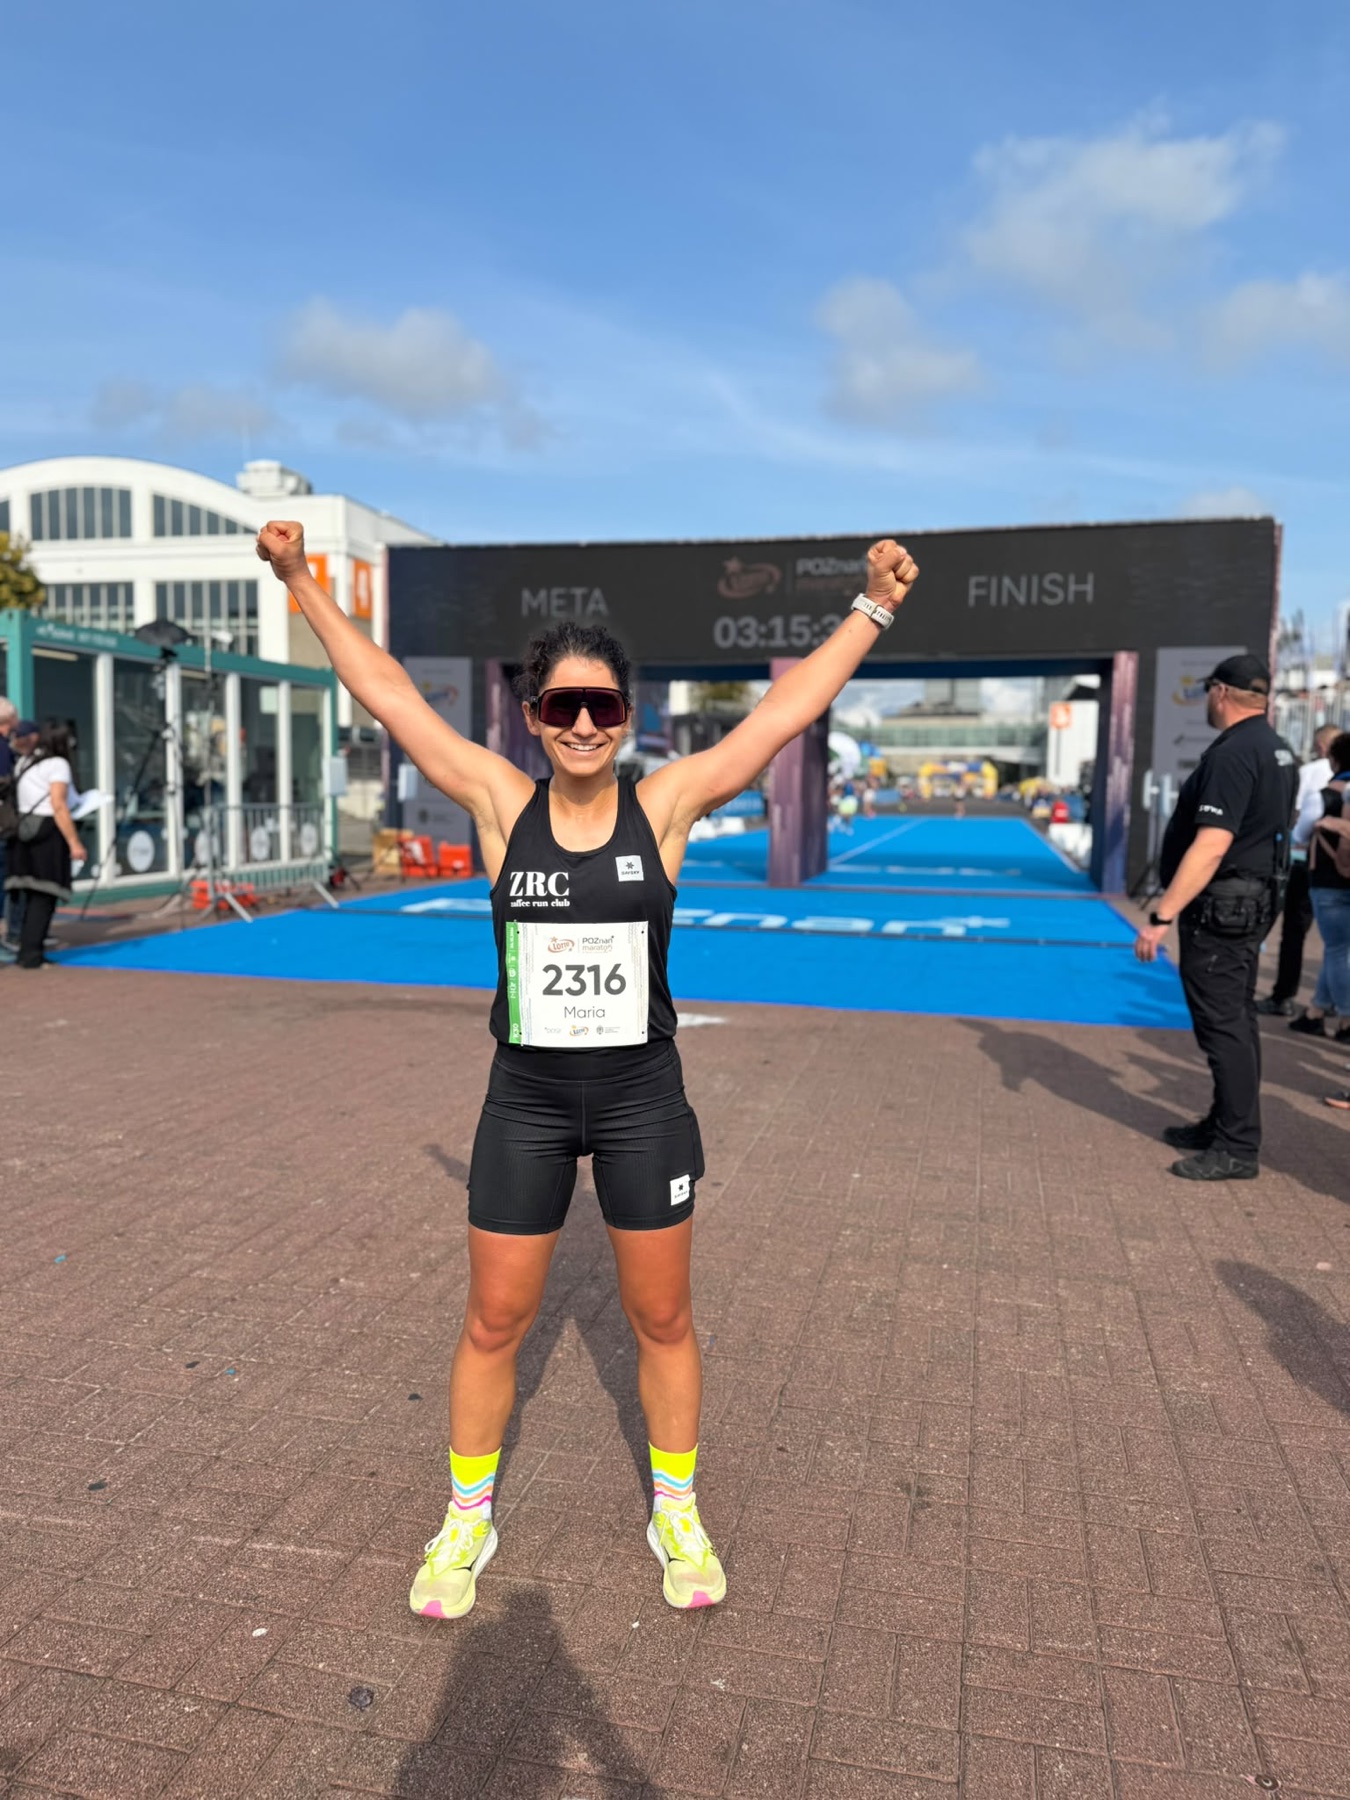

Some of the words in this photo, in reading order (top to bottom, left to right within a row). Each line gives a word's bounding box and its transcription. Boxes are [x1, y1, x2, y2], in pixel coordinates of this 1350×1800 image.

[521, 586, 610, 617] META
[967, 571, 1095, 607] FINISH
[509, 871, 570, 896] ZRC
[550, 898, 571, 907] club
[542, 963, 627, 996] 2316
[564, 1005, 606, 1019] Maria
